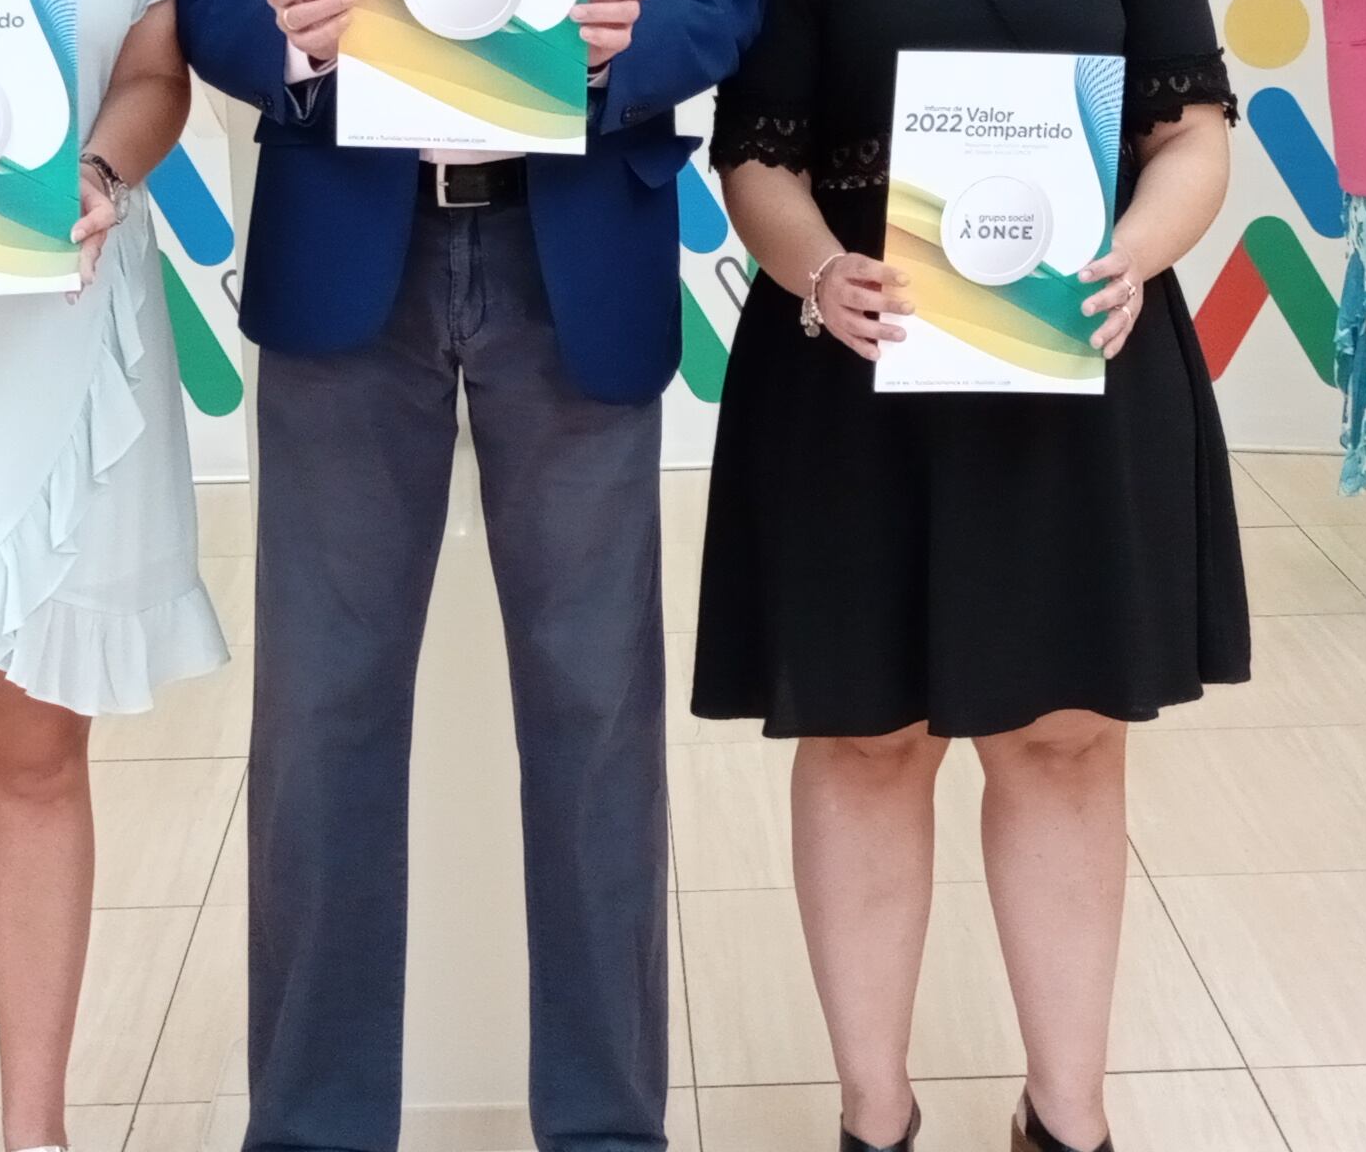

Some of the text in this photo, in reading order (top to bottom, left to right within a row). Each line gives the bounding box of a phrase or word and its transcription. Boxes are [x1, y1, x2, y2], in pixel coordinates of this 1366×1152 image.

[905, 107, 1014, 132] 2022 Valor
[965, 123, 1073, 140] compartido
[978, 214, 1034, 225] grupo social
[978, 226, 1033, 240] ONCE
